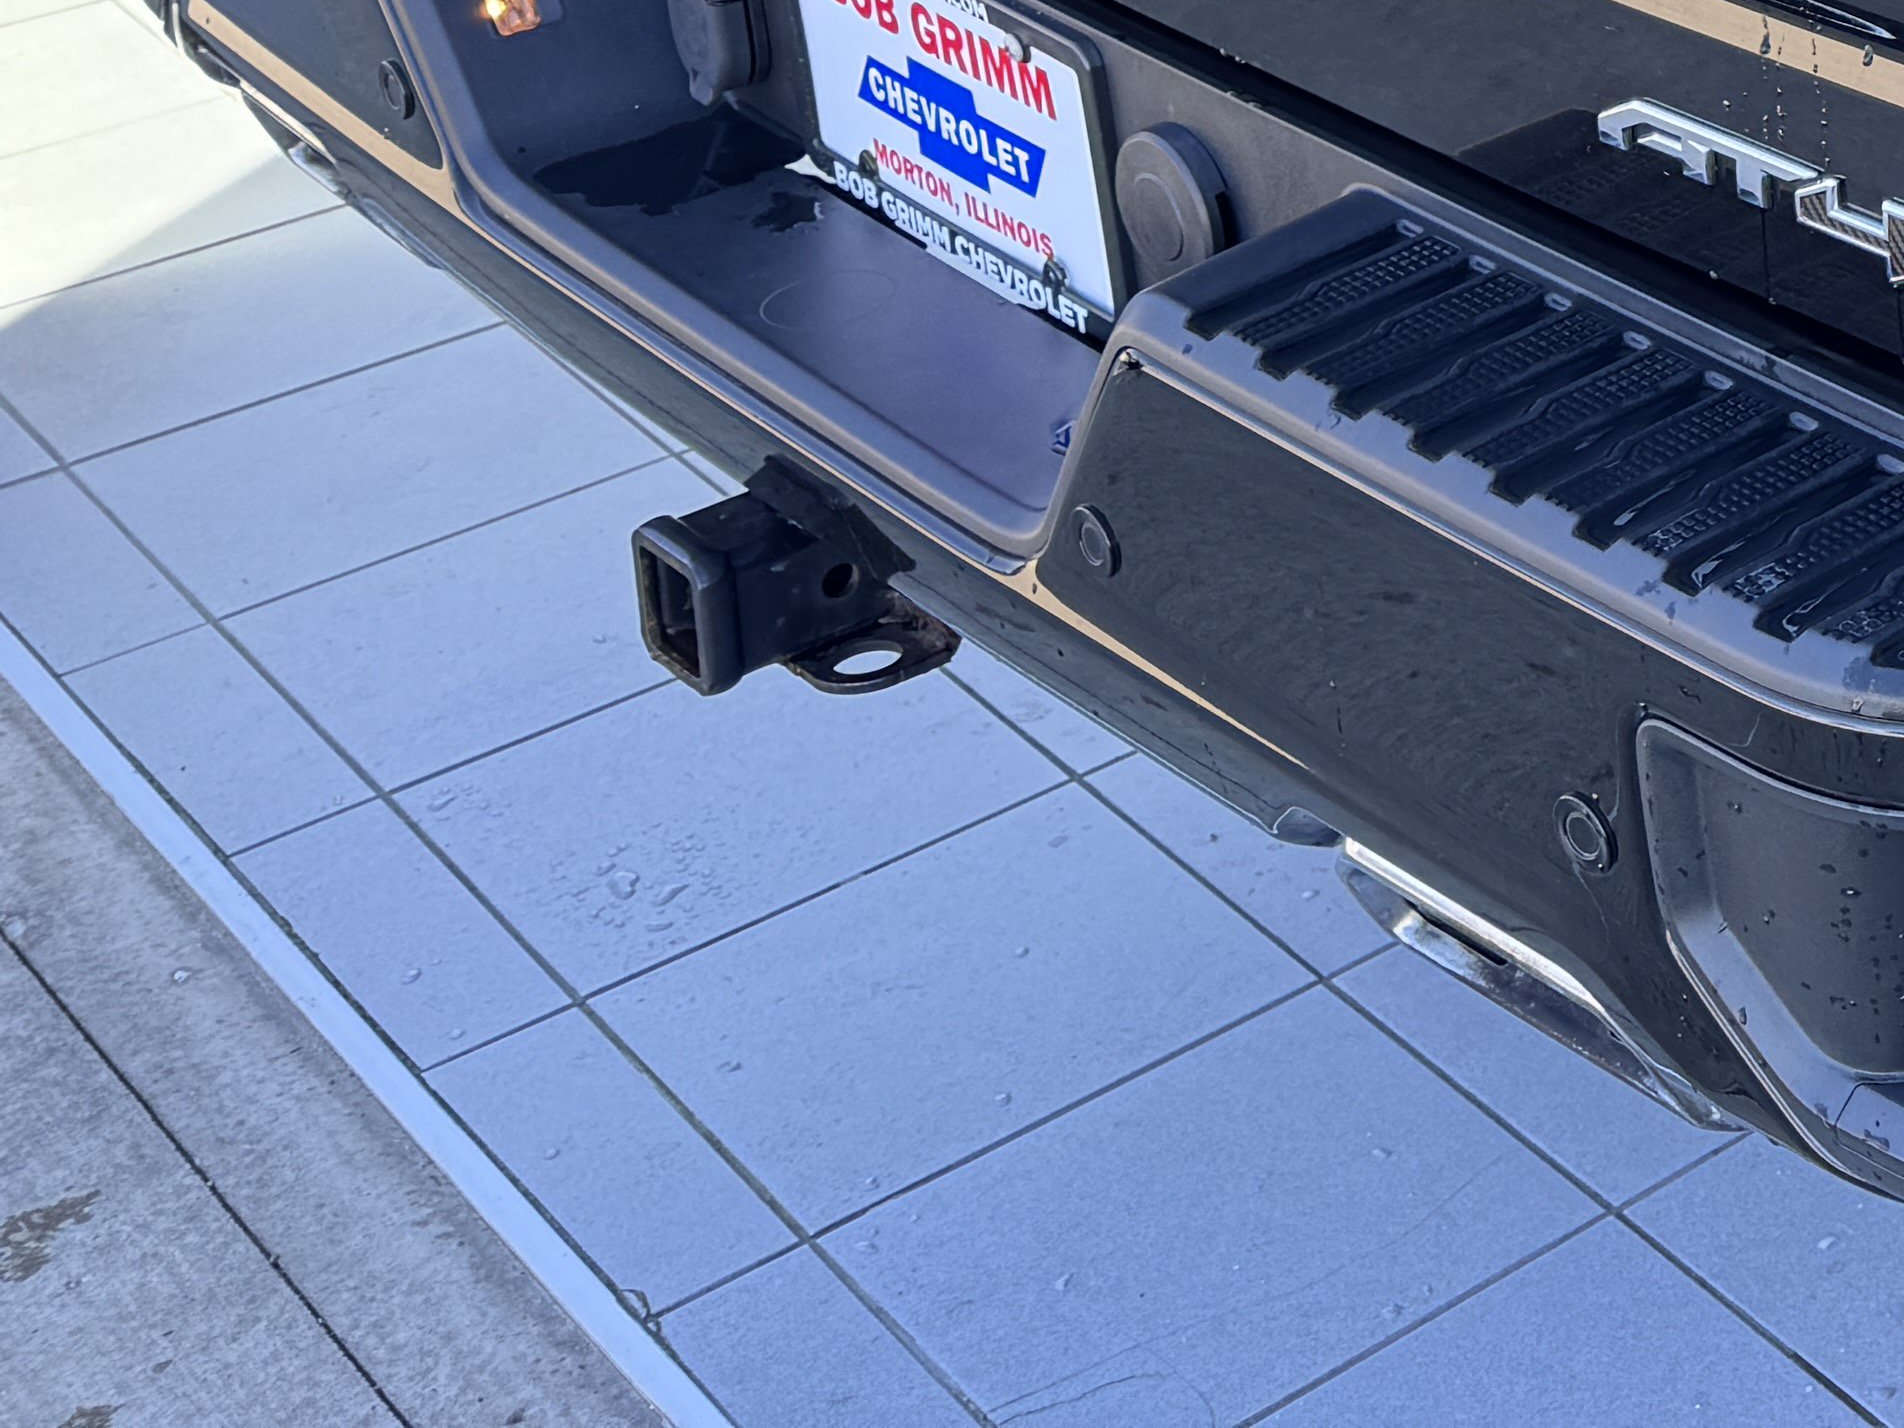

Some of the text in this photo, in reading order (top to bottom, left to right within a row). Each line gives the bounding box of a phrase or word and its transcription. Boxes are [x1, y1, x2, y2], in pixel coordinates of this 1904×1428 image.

[911, 2, 1057, 121] GRIMM
[868, 66, 1031, 184] CHEVROLET
[833, 160, 1088, 334] BOB GRIMM CHEVROLET
[873, 137, 1055, 261] MORTON, ILLINOIS
